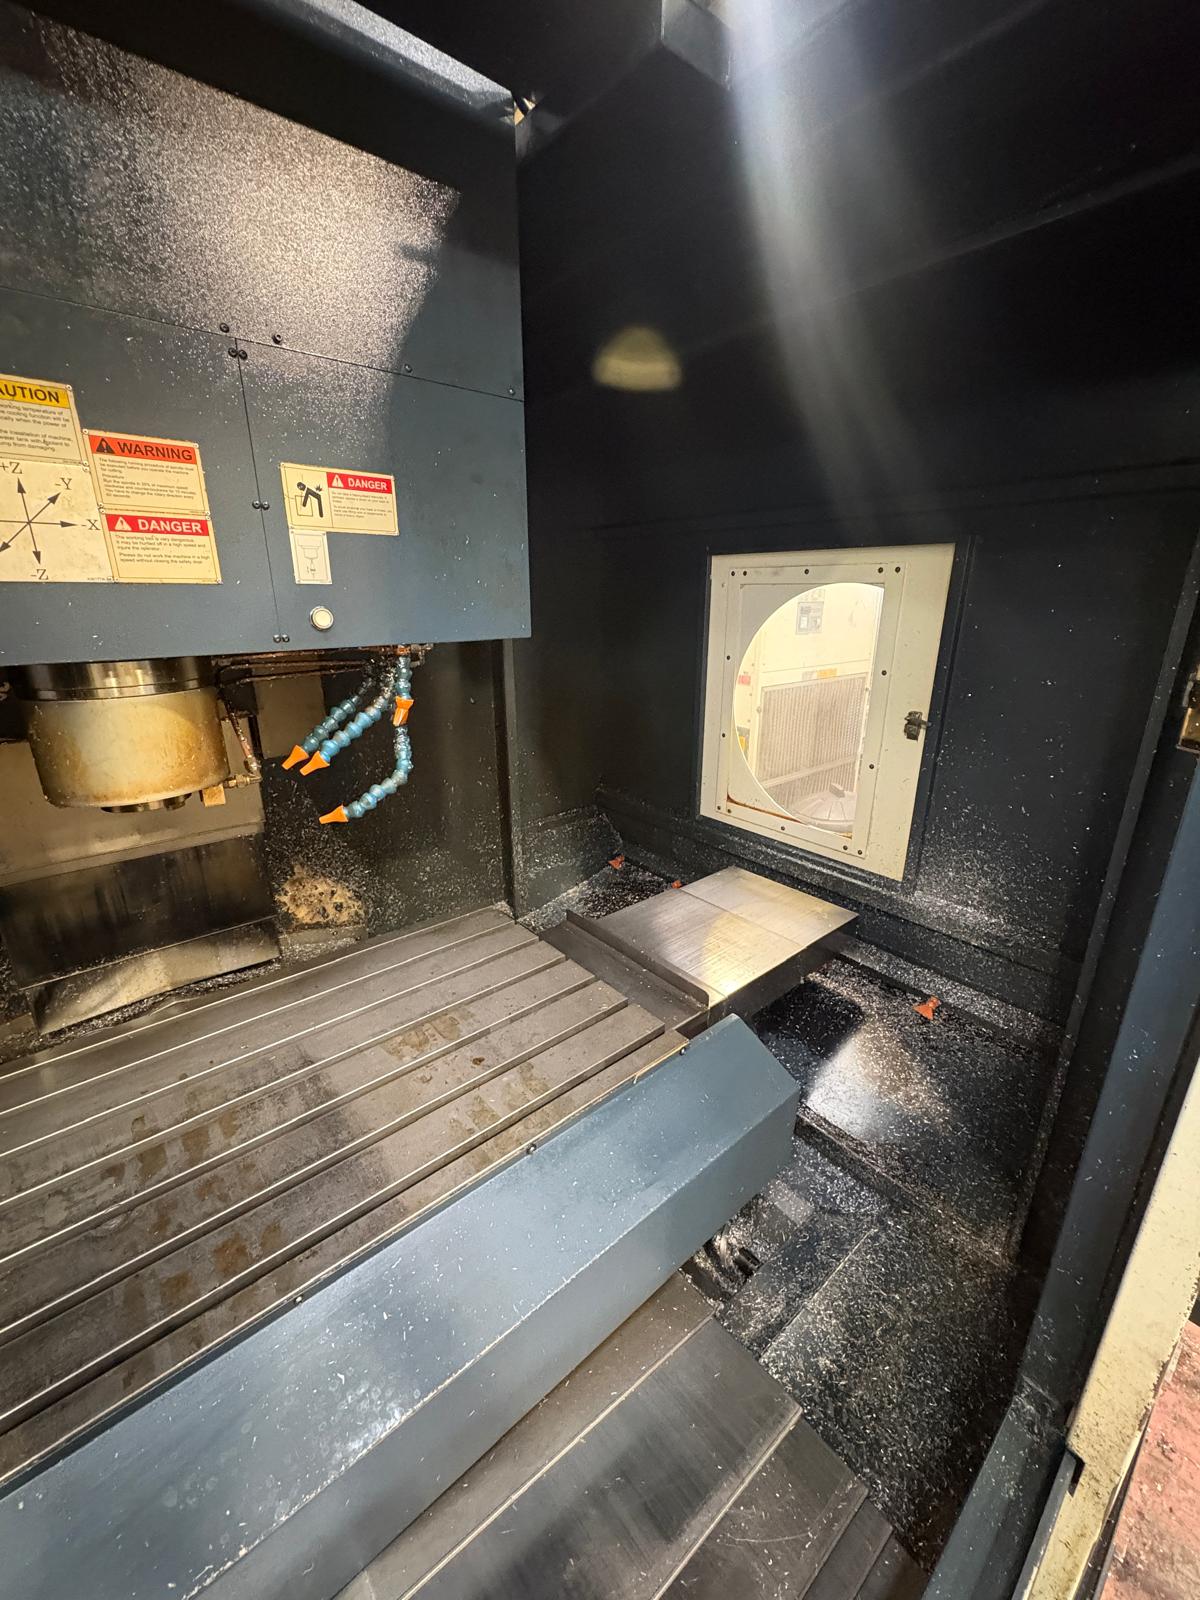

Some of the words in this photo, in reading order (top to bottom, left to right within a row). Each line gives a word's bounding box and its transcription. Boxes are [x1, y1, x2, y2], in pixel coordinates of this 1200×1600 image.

[118, 442, 192, 460] WARNING
[0, 461, 22, 474] +Z
[55, 477, 72, 490] -Y
[348, 478, 387, 490] DANGER
[81, 519, 101, 531] -X
[138, 519, 202, 533] DANGER
[30, 569, 48, 580] -Z
